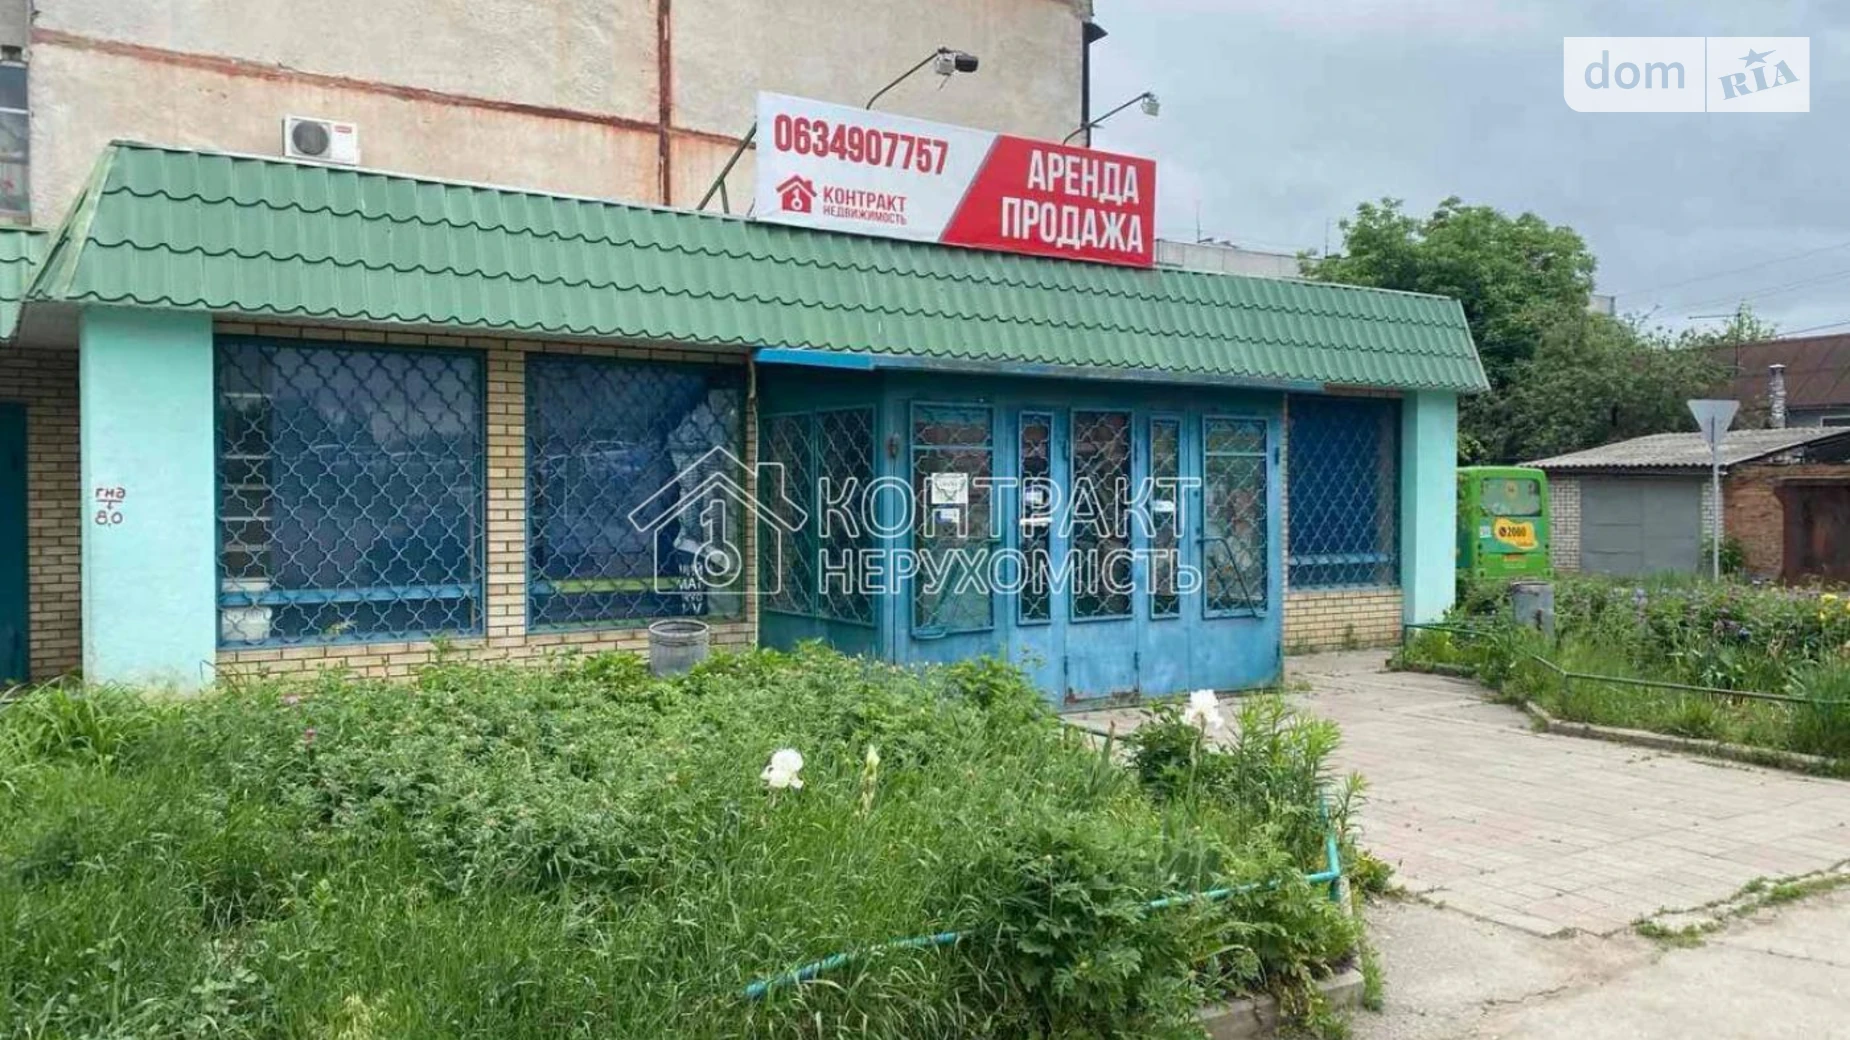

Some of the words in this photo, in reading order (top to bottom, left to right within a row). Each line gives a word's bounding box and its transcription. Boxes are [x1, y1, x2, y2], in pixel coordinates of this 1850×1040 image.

[774, 114, 948, 175] 0634907757
[823, 186, 907, 212] КОНТРАКТ
[1028, 149, 1140, 205] АРЕНДА
[823, 205, 907, 225] НЕДВИЖИМОСТЬ
[1002, 196, 1144, 254] ПРОДАЖА
